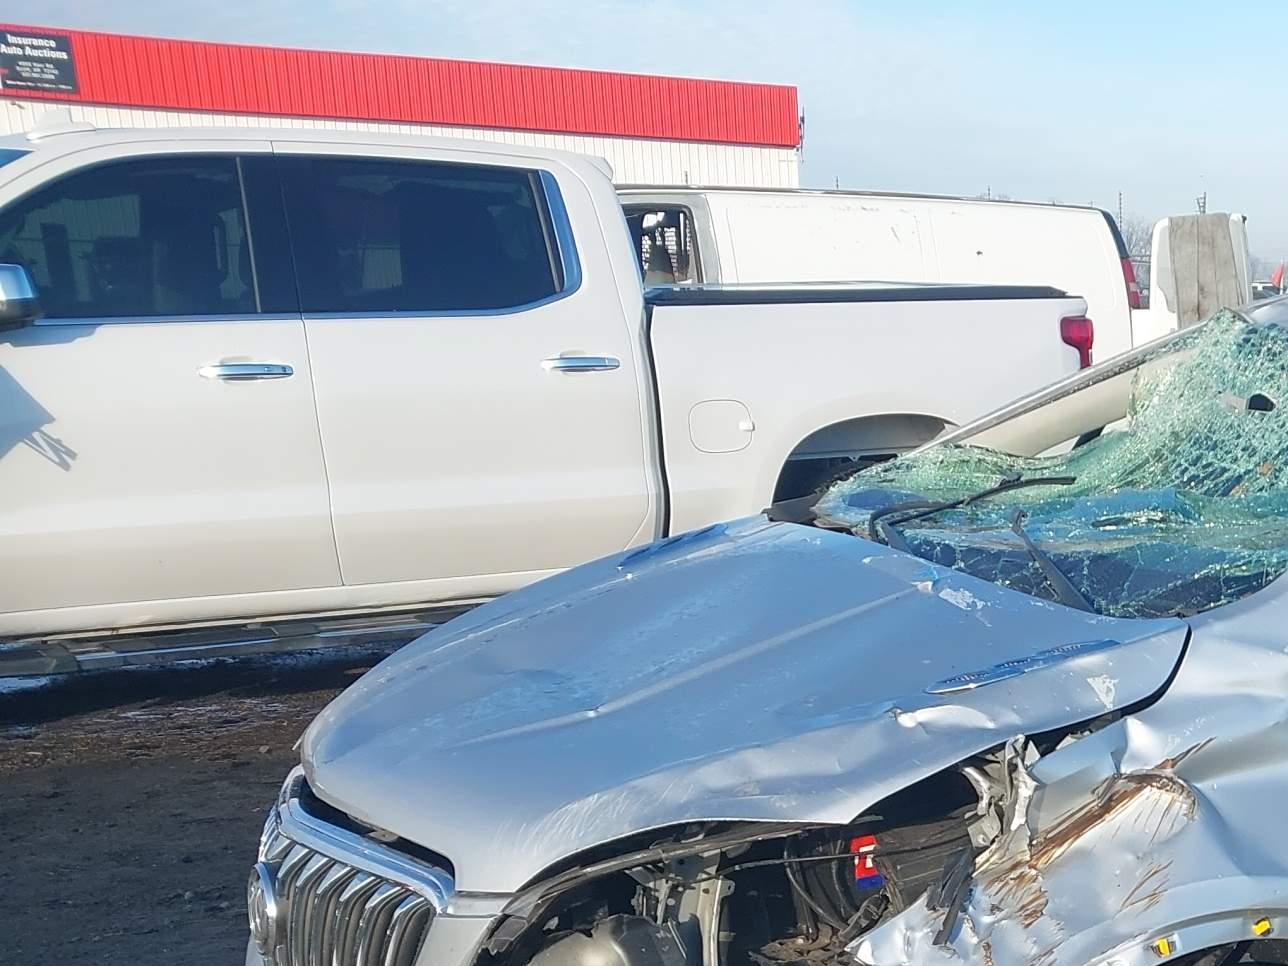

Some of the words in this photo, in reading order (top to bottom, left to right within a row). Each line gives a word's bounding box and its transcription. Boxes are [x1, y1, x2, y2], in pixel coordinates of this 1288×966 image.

[6, 33, 56, 48] Insurance
[0, 43, 23, 55] Auto
[25, 46, 68, 59] Auctions
